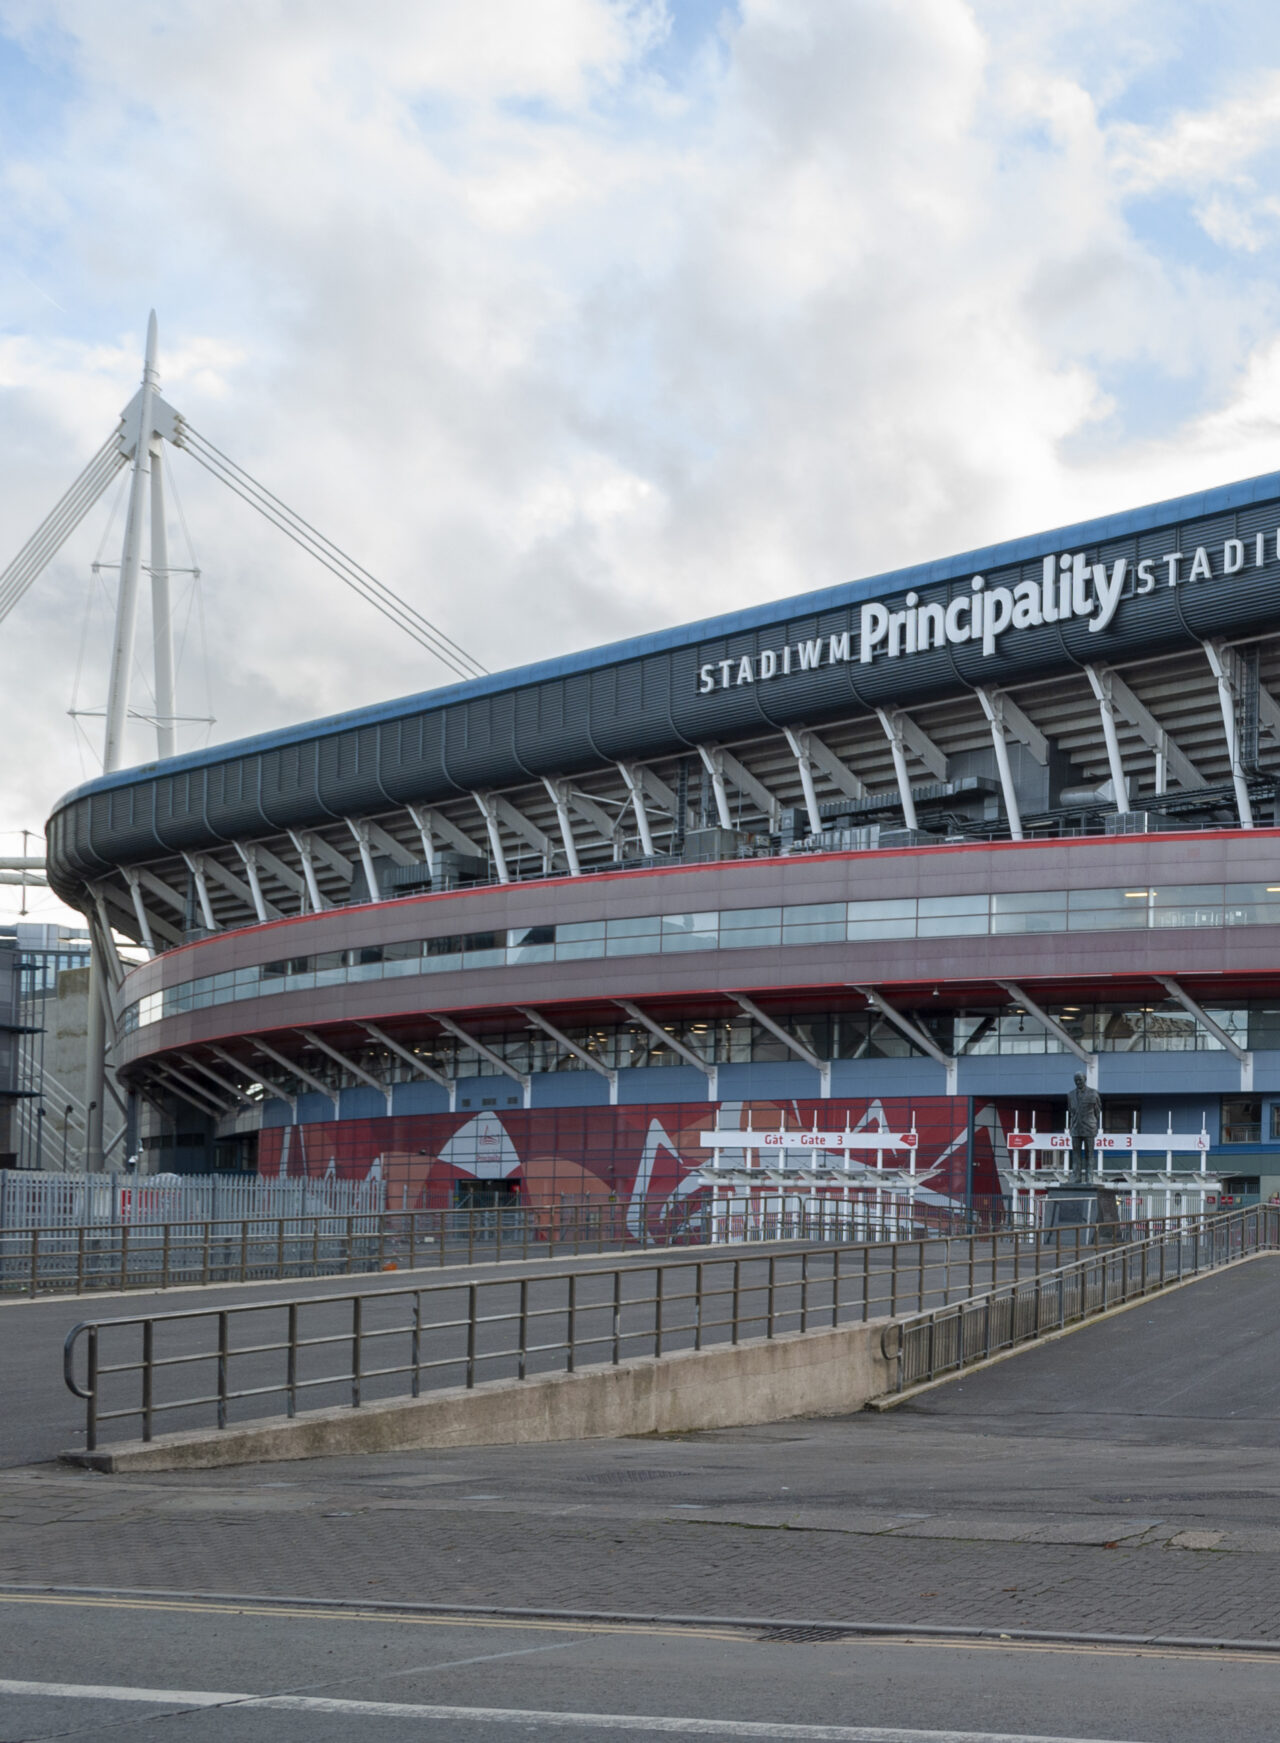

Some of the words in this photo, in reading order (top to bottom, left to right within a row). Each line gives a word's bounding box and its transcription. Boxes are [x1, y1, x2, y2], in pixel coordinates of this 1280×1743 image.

[700, 632, 850, 693] STADIWM
[860, 553, 1127, 664] Principality
[801, 1134, 826, 1145] Gate
[837, 1135, 843, 1145] 3
[1095, 1136, 1114, 1147] ate
[1126, 1136, 1132, 1147] 3
